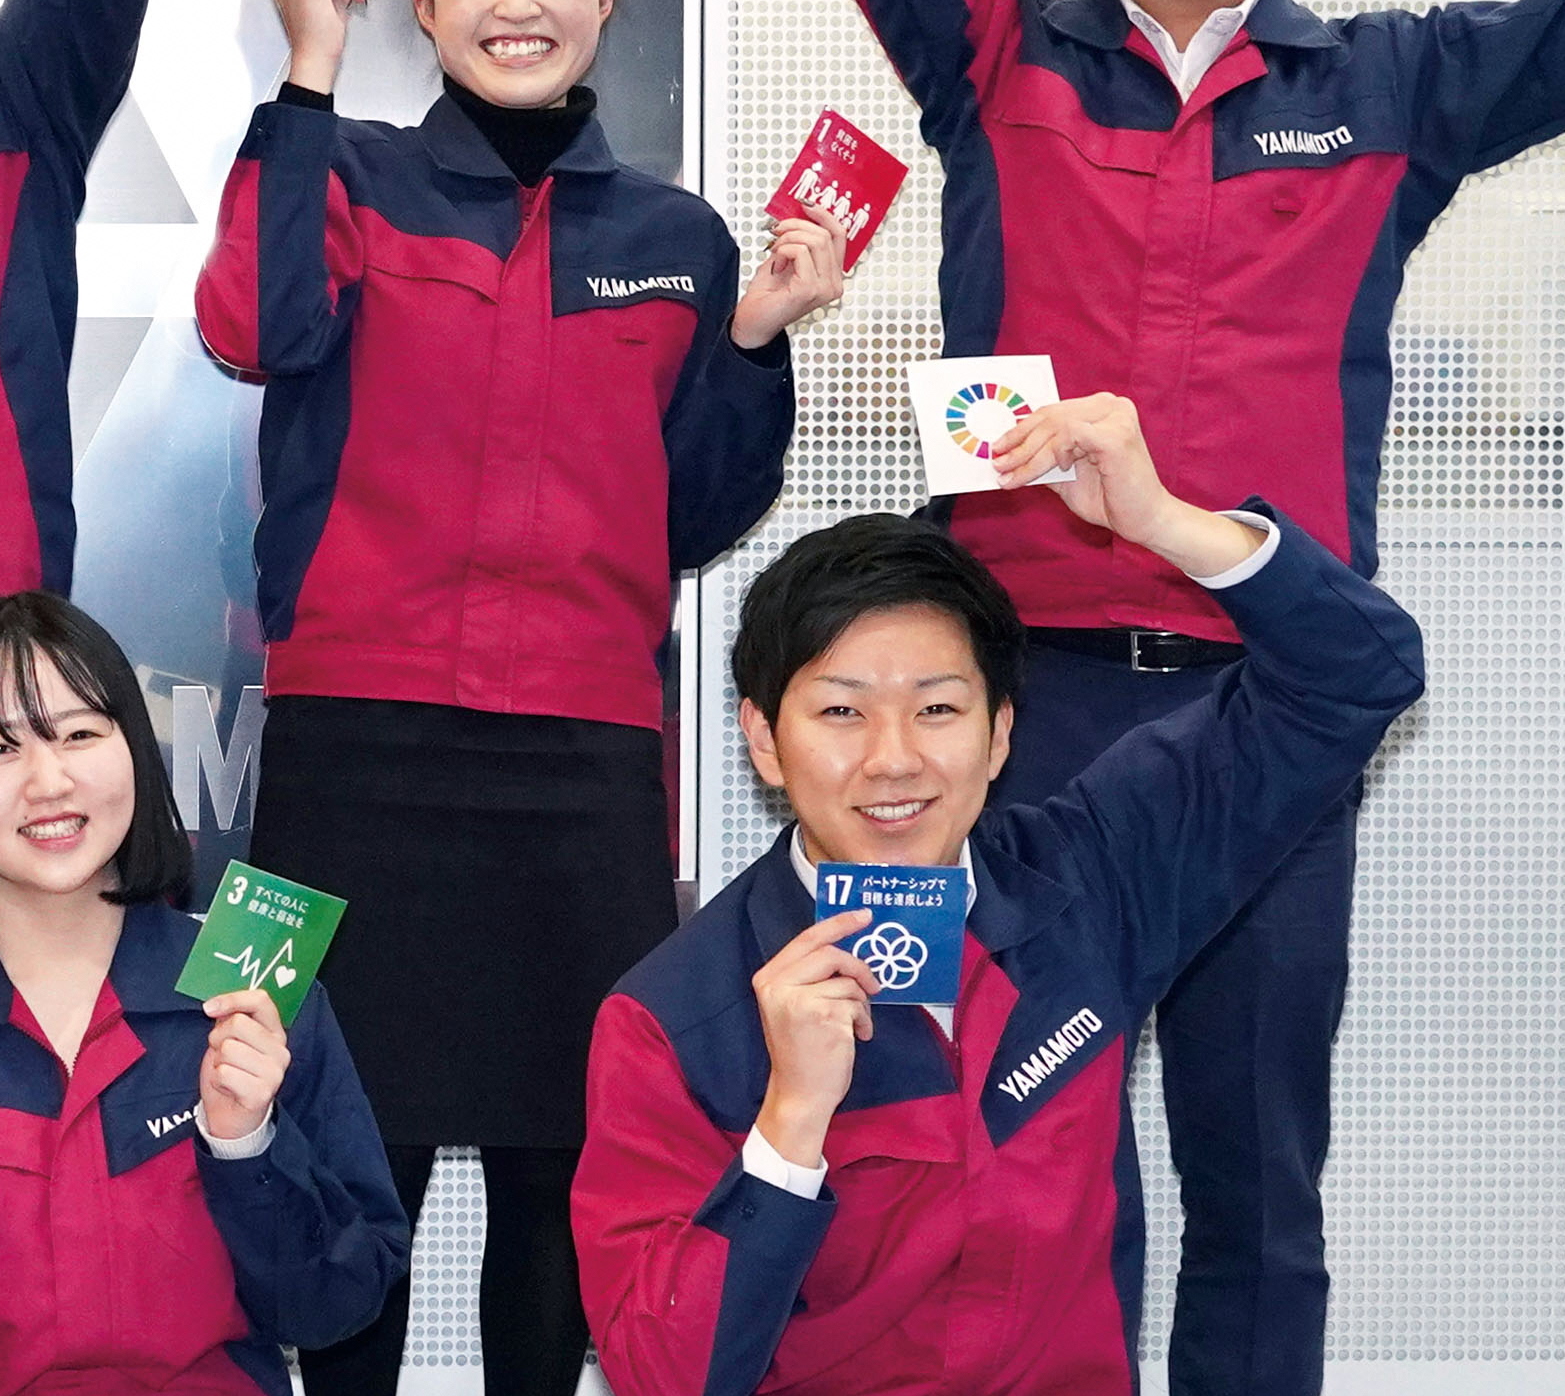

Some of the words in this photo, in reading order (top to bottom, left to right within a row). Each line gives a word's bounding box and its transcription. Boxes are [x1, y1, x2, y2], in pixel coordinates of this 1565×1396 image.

[817, 118, 833, 143] 1
[1253, 125, 1354, 156] YAMAMOTO
[830, 141, 856, 165] なくそう
[586, 275, 695, 298] YAMAMOTO
[227, 875, 248, 905] 3
[824, 874, 853, 906] 17
[862, 876, 947, 891] パートナーシップで
[255, 885, 309, 914] すべての人に
[861, 891, 944, 907] 目標を達成しよう
[247, 898, 305, 930] 健康と福祉を
[998, 1007, 1103, 1103] YAMAMOTO
